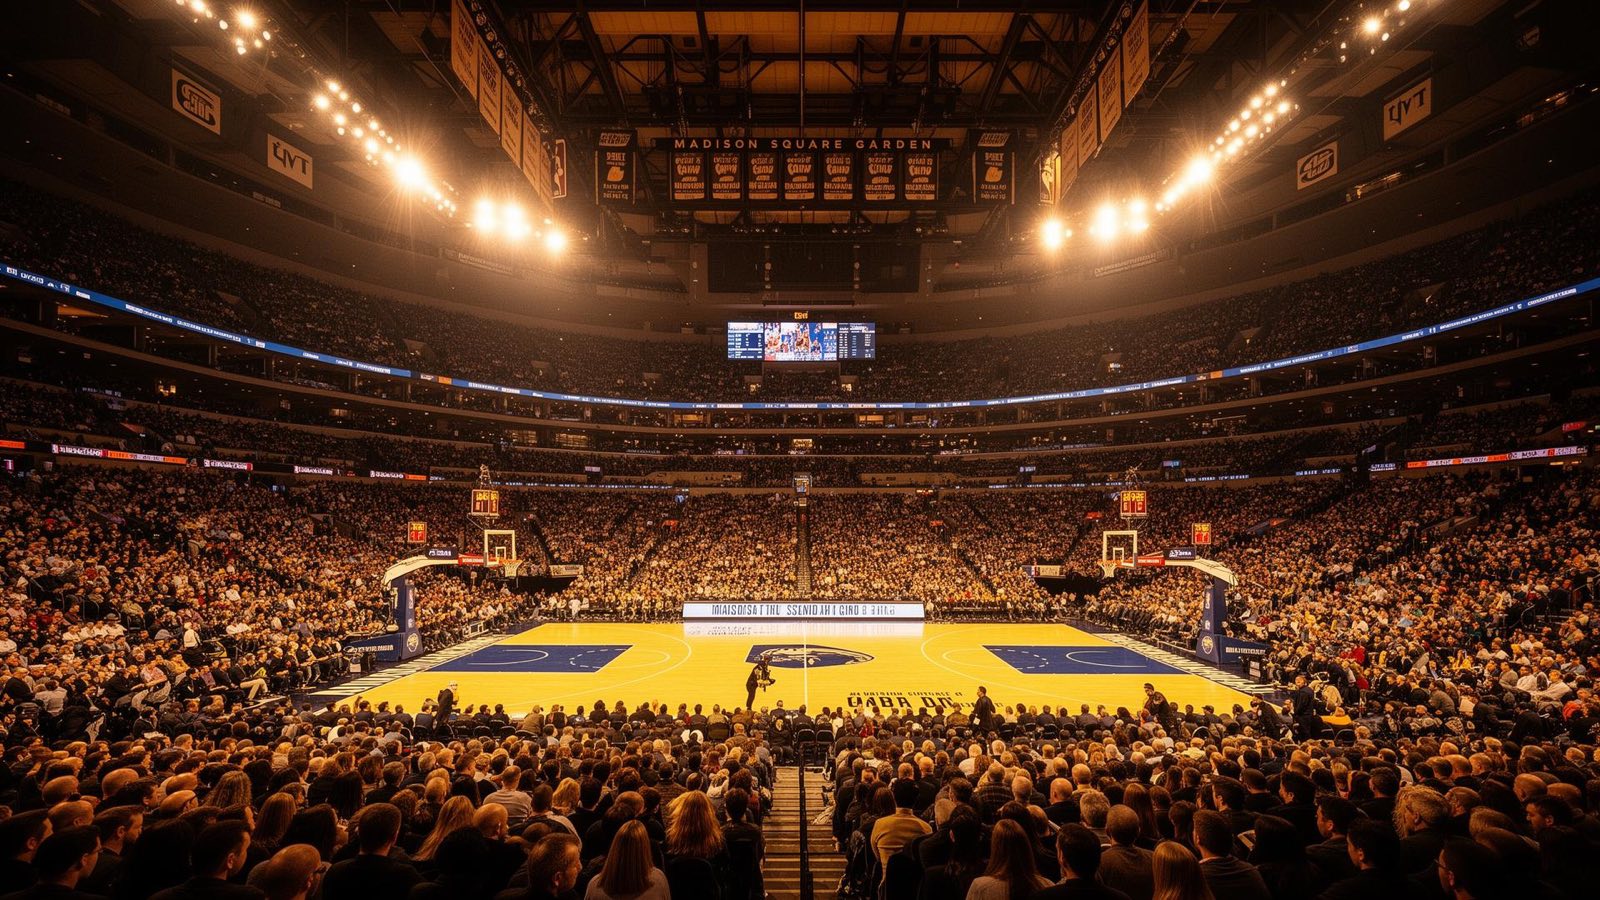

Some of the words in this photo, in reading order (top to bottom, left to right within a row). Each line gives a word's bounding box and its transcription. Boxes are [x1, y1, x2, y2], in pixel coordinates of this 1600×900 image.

[674, 138, 758, 149] MADISON
[770, 138, 843, 150] SQUARE
[855, 138, 932, 149] GARDEN
